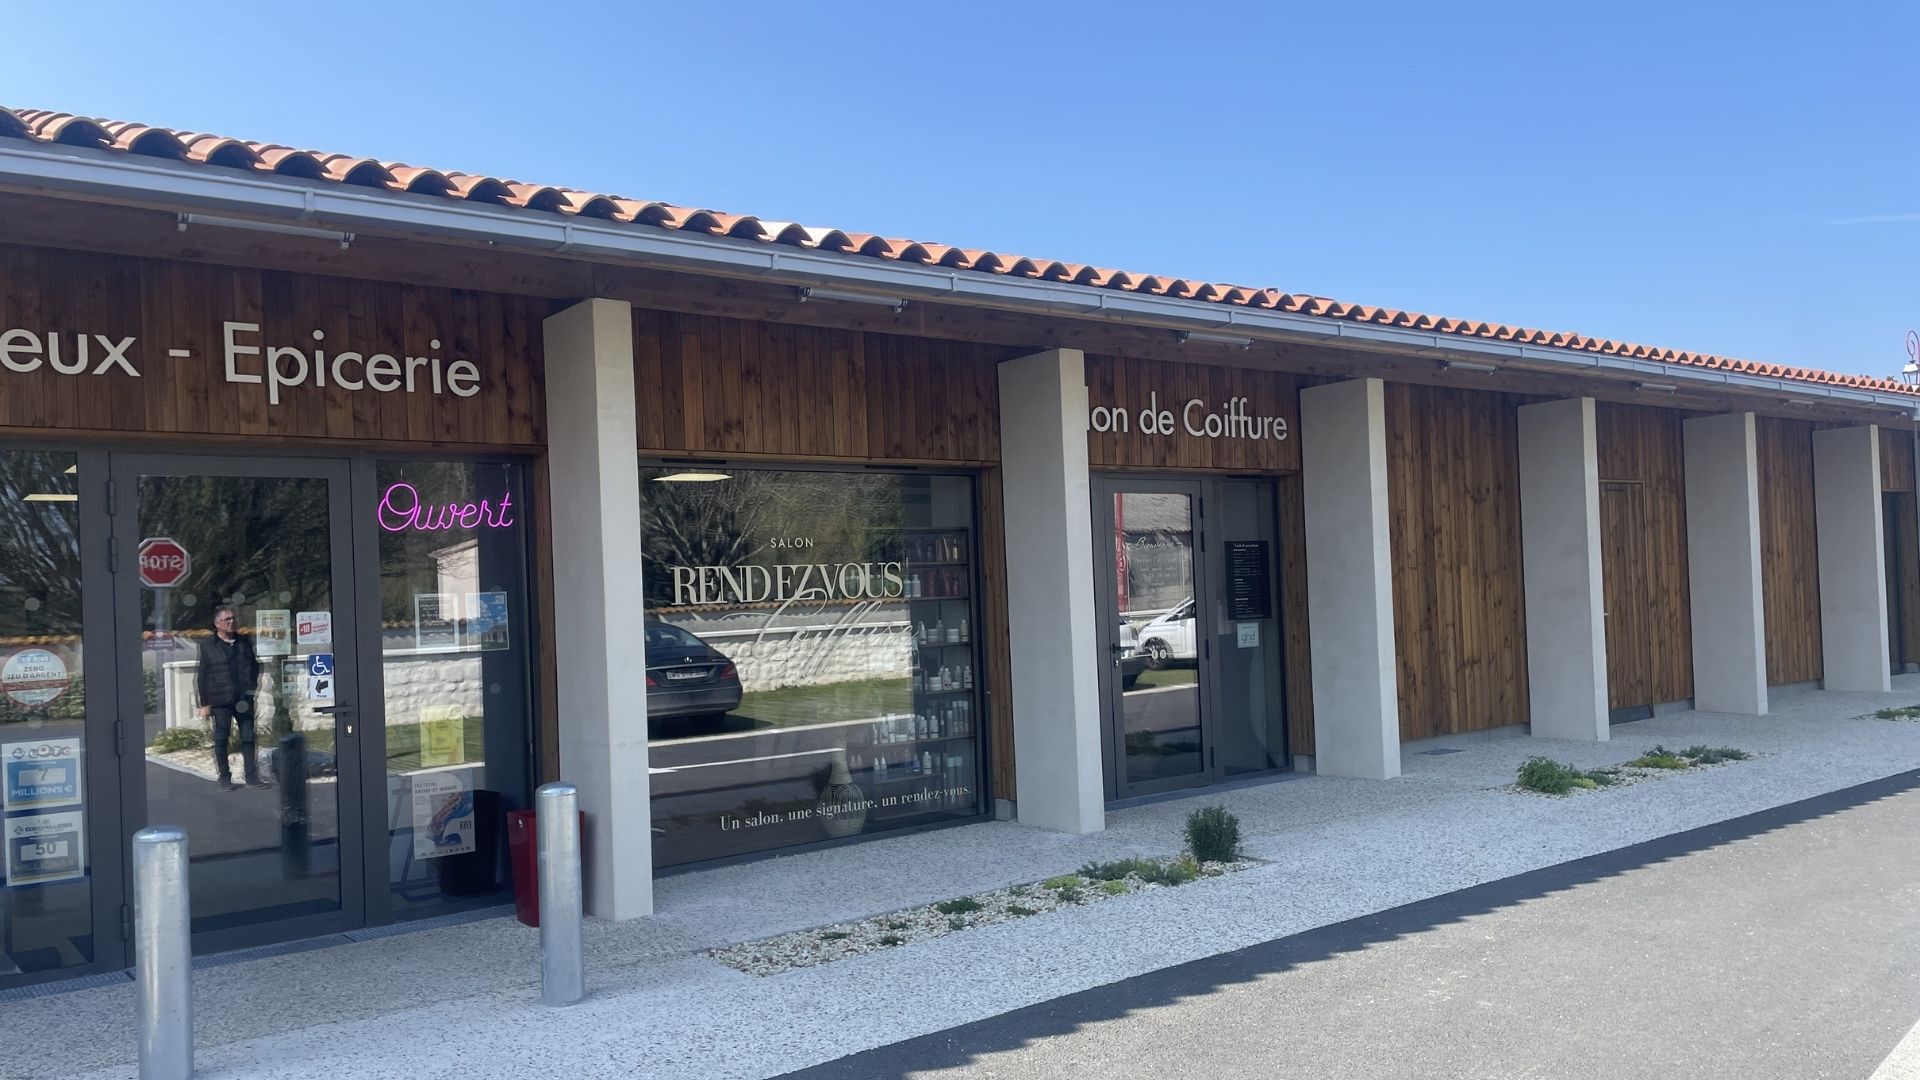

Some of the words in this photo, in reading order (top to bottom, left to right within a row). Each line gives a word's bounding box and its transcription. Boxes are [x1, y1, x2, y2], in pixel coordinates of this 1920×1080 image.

[0, 328, 141, 377] eux
[169, 349, 190, 357] -
[223, 321, 481, 404] Epicerie
[1139, 391, 1175, 435] de
[1183, 396, 1288, 440] Coiffure
[378, 483, 514, 531] Ouvert
[770, 537, 814, 548] SALON
[28, 745, 72, 758] LOTO
[38, 768, 49, 781] 7
[12, 785, 63, 797] MILLIONS
[720, 815, 741, 831] Un
[788, 806, 813, 821] une
[881, 795, 898, 807] un
[35, 841, 56, 855] 50
